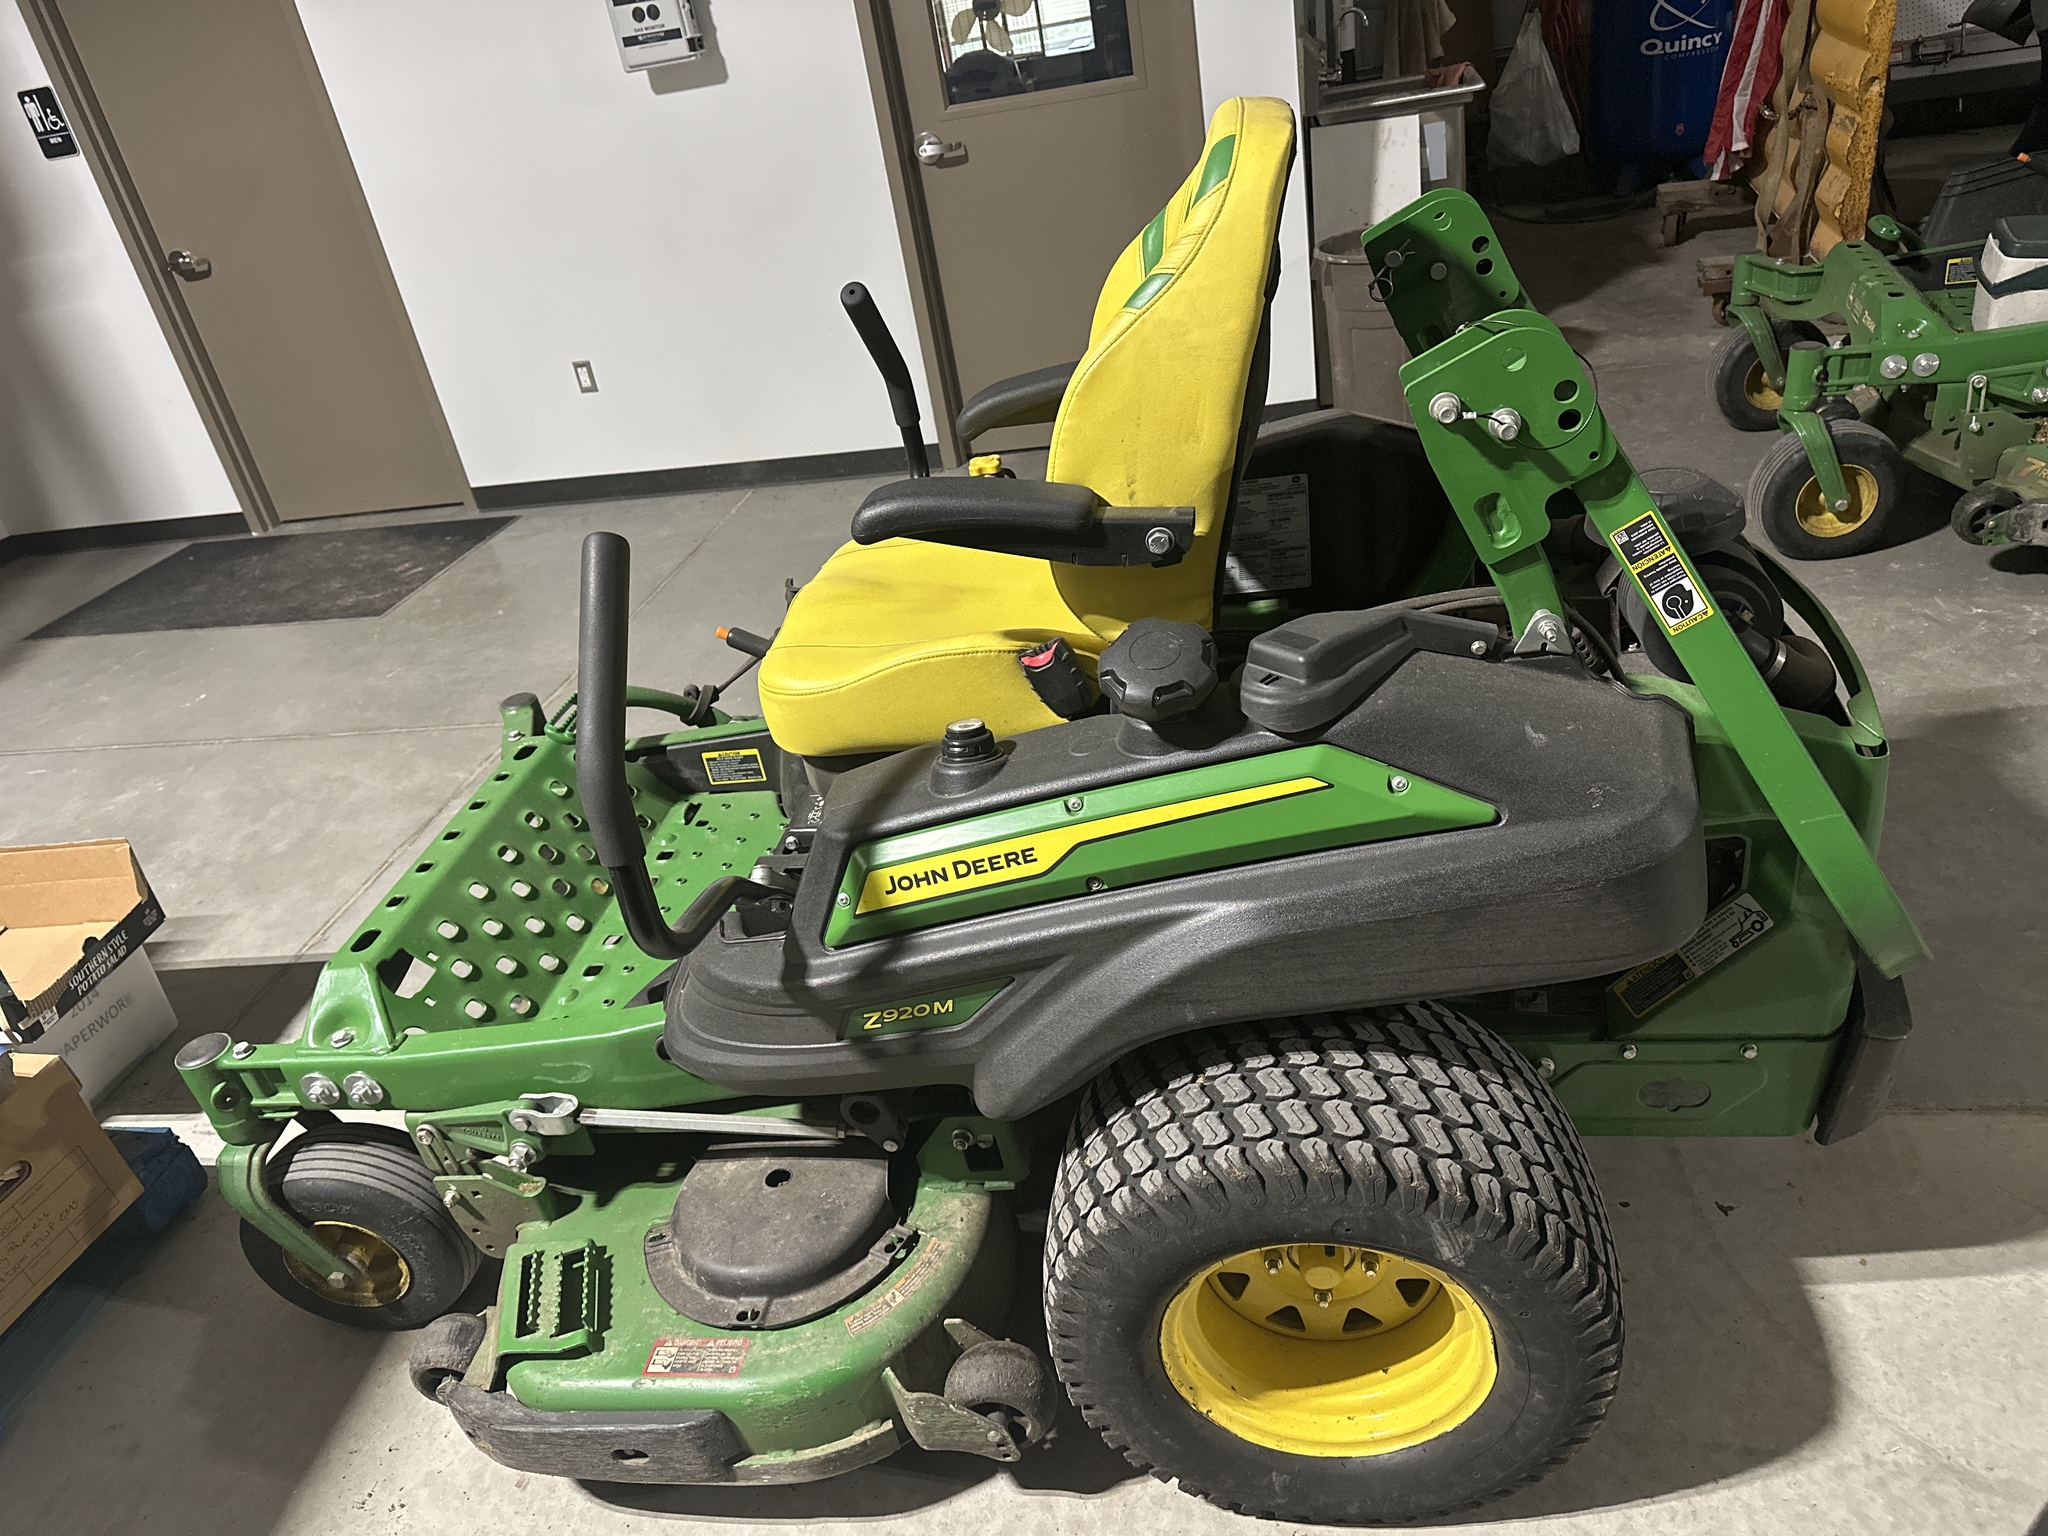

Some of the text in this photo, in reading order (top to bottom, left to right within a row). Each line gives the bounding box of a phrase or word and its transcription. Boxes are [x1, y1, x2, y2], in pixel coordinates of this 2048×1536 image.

[49, 136, 62, 144] MEN
[1632, 548, 1666, 572] ATENCIÓN
[1672, 613, 1704, 632] CAUTION
[885, 847, 1038, 895] JOHN DEERE
[69, 930, 128, 990] SOUTHERN STYLE
[77, 945, 127, 996] POTATO SALAD
[59, 992, 135, 1057] APERWORK
[863, 999, 954, 1030] Z920M
[716, 1338, 743, 1346] PELIGRO
